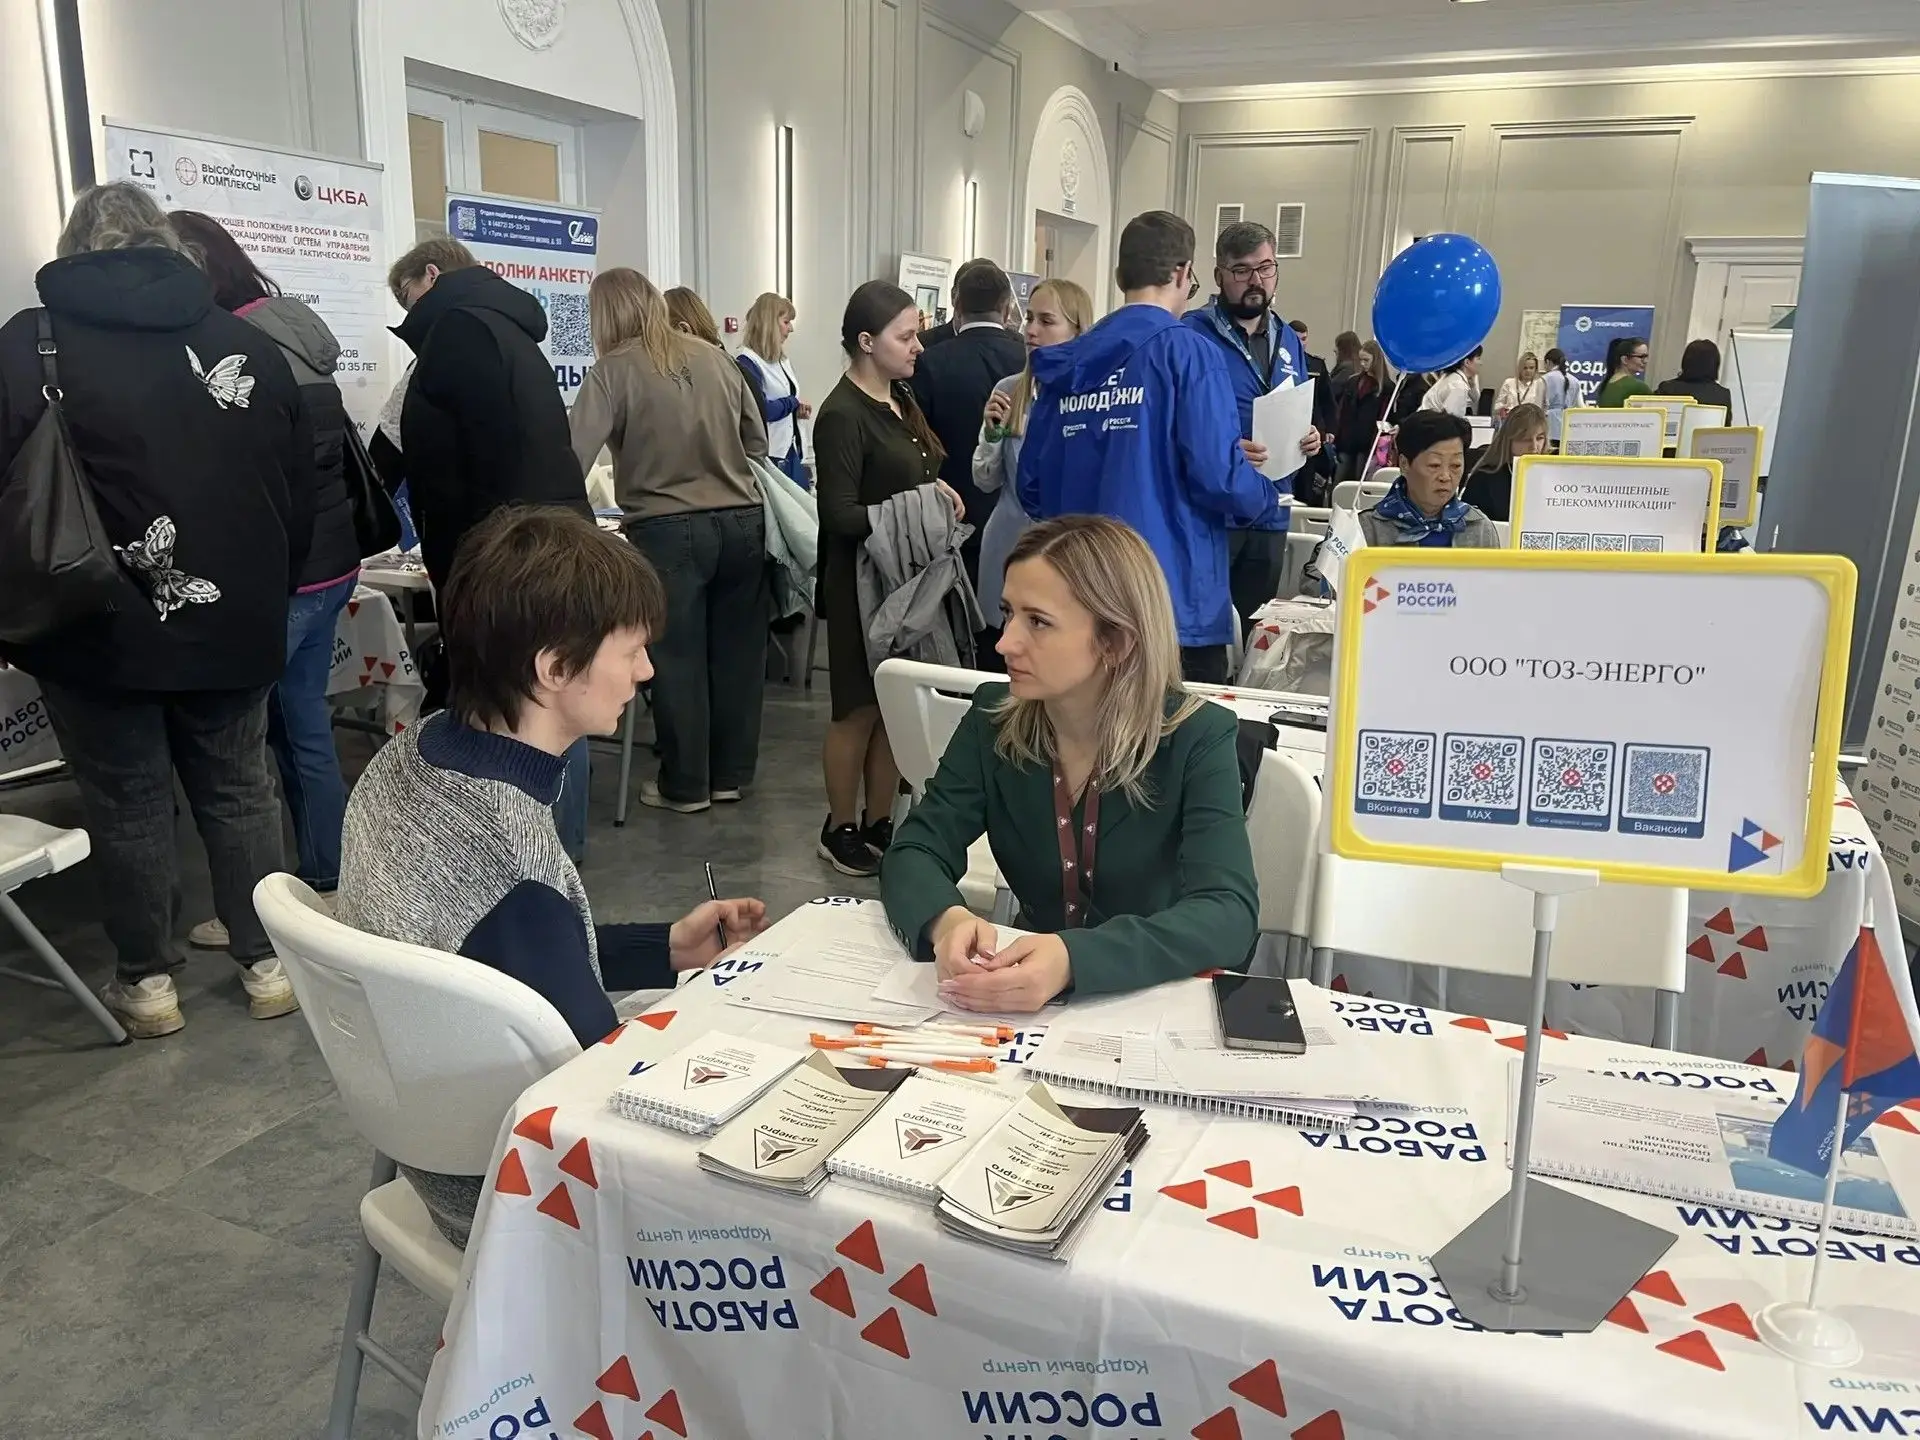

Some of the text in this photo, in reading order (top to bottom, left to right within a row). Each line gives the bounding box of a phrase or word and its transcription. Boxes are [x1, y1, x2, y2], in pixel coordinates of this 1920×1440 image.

[201, 163, 277, 185] ВЫСОКОТОЧНЫЕ
[202, 174, 261, 192] КОМПЛЕКСЫ
[317, 186, 369, 207] ЦКБА
[246, 221, 293, 233] ПОЛОЖЕНИЕ
[294, 225, 300, 233] В
[301, 226, 331, 236] РОССИИ
[340, 230, 370, 242] ОБЛАСТИ
[261, 244, 296, 256] БЛИЖНЕЙ
[299, 248, 351, 260] ТАКТИЧЕСКОЙ
[293, 236, 322, 248] СИСТЕМ
[326, 240, 370, 252] УПРАВЛЕНИЯ
[484, 261, 594, 285] ПОЛНИ АНКЕТУ
[338, 349, 359, 358] КОВ
[347, 363, 360, 372] 35
[362, 363, 377, 372] ЛЕТ
[1554, 484, 1670, 496] ООО "ЗАЩИЩЕННЫЕ
[1546, 498, 1677, 510] ТЕЛЕКОММУНИКАЦИИ"
[1398, 582, 1454, 594] РАБОТА
[1398, 596, 1457, 608] РОССИИ
[1450, 656, 1706, 685] ООО "ТОЗ-ЭНЕРГО"
[1, 714, 49, 752] РОСС
[1366, 802, 1420, 816] ВКонтакте
[1634, 821, 1688, 835] Вакансии
[1778, 980, 1829, 1004] СИИ
[1350, 1115, 1478, 1140] РОСС
[1298, 1131, 1488, 1162] РАБОТА
[636, 1227, 770, 1245] Кадровый центр
[1344, 1246, 1410, 1262] центр
[1702, 1233, 1920, 1266] РАБОТА
[626, 1255, 787, 1292] РОССИИ
[646, 1297, 800, 1333] РАБОТА
[1328, 1296, 1486, 1333] БОТА
[983, 1358, 1149, 1376] Кадровый центр
[1828, 1377, 1910, 1394] центр
[961, 1390, 1162, 1428] РОССИИ
